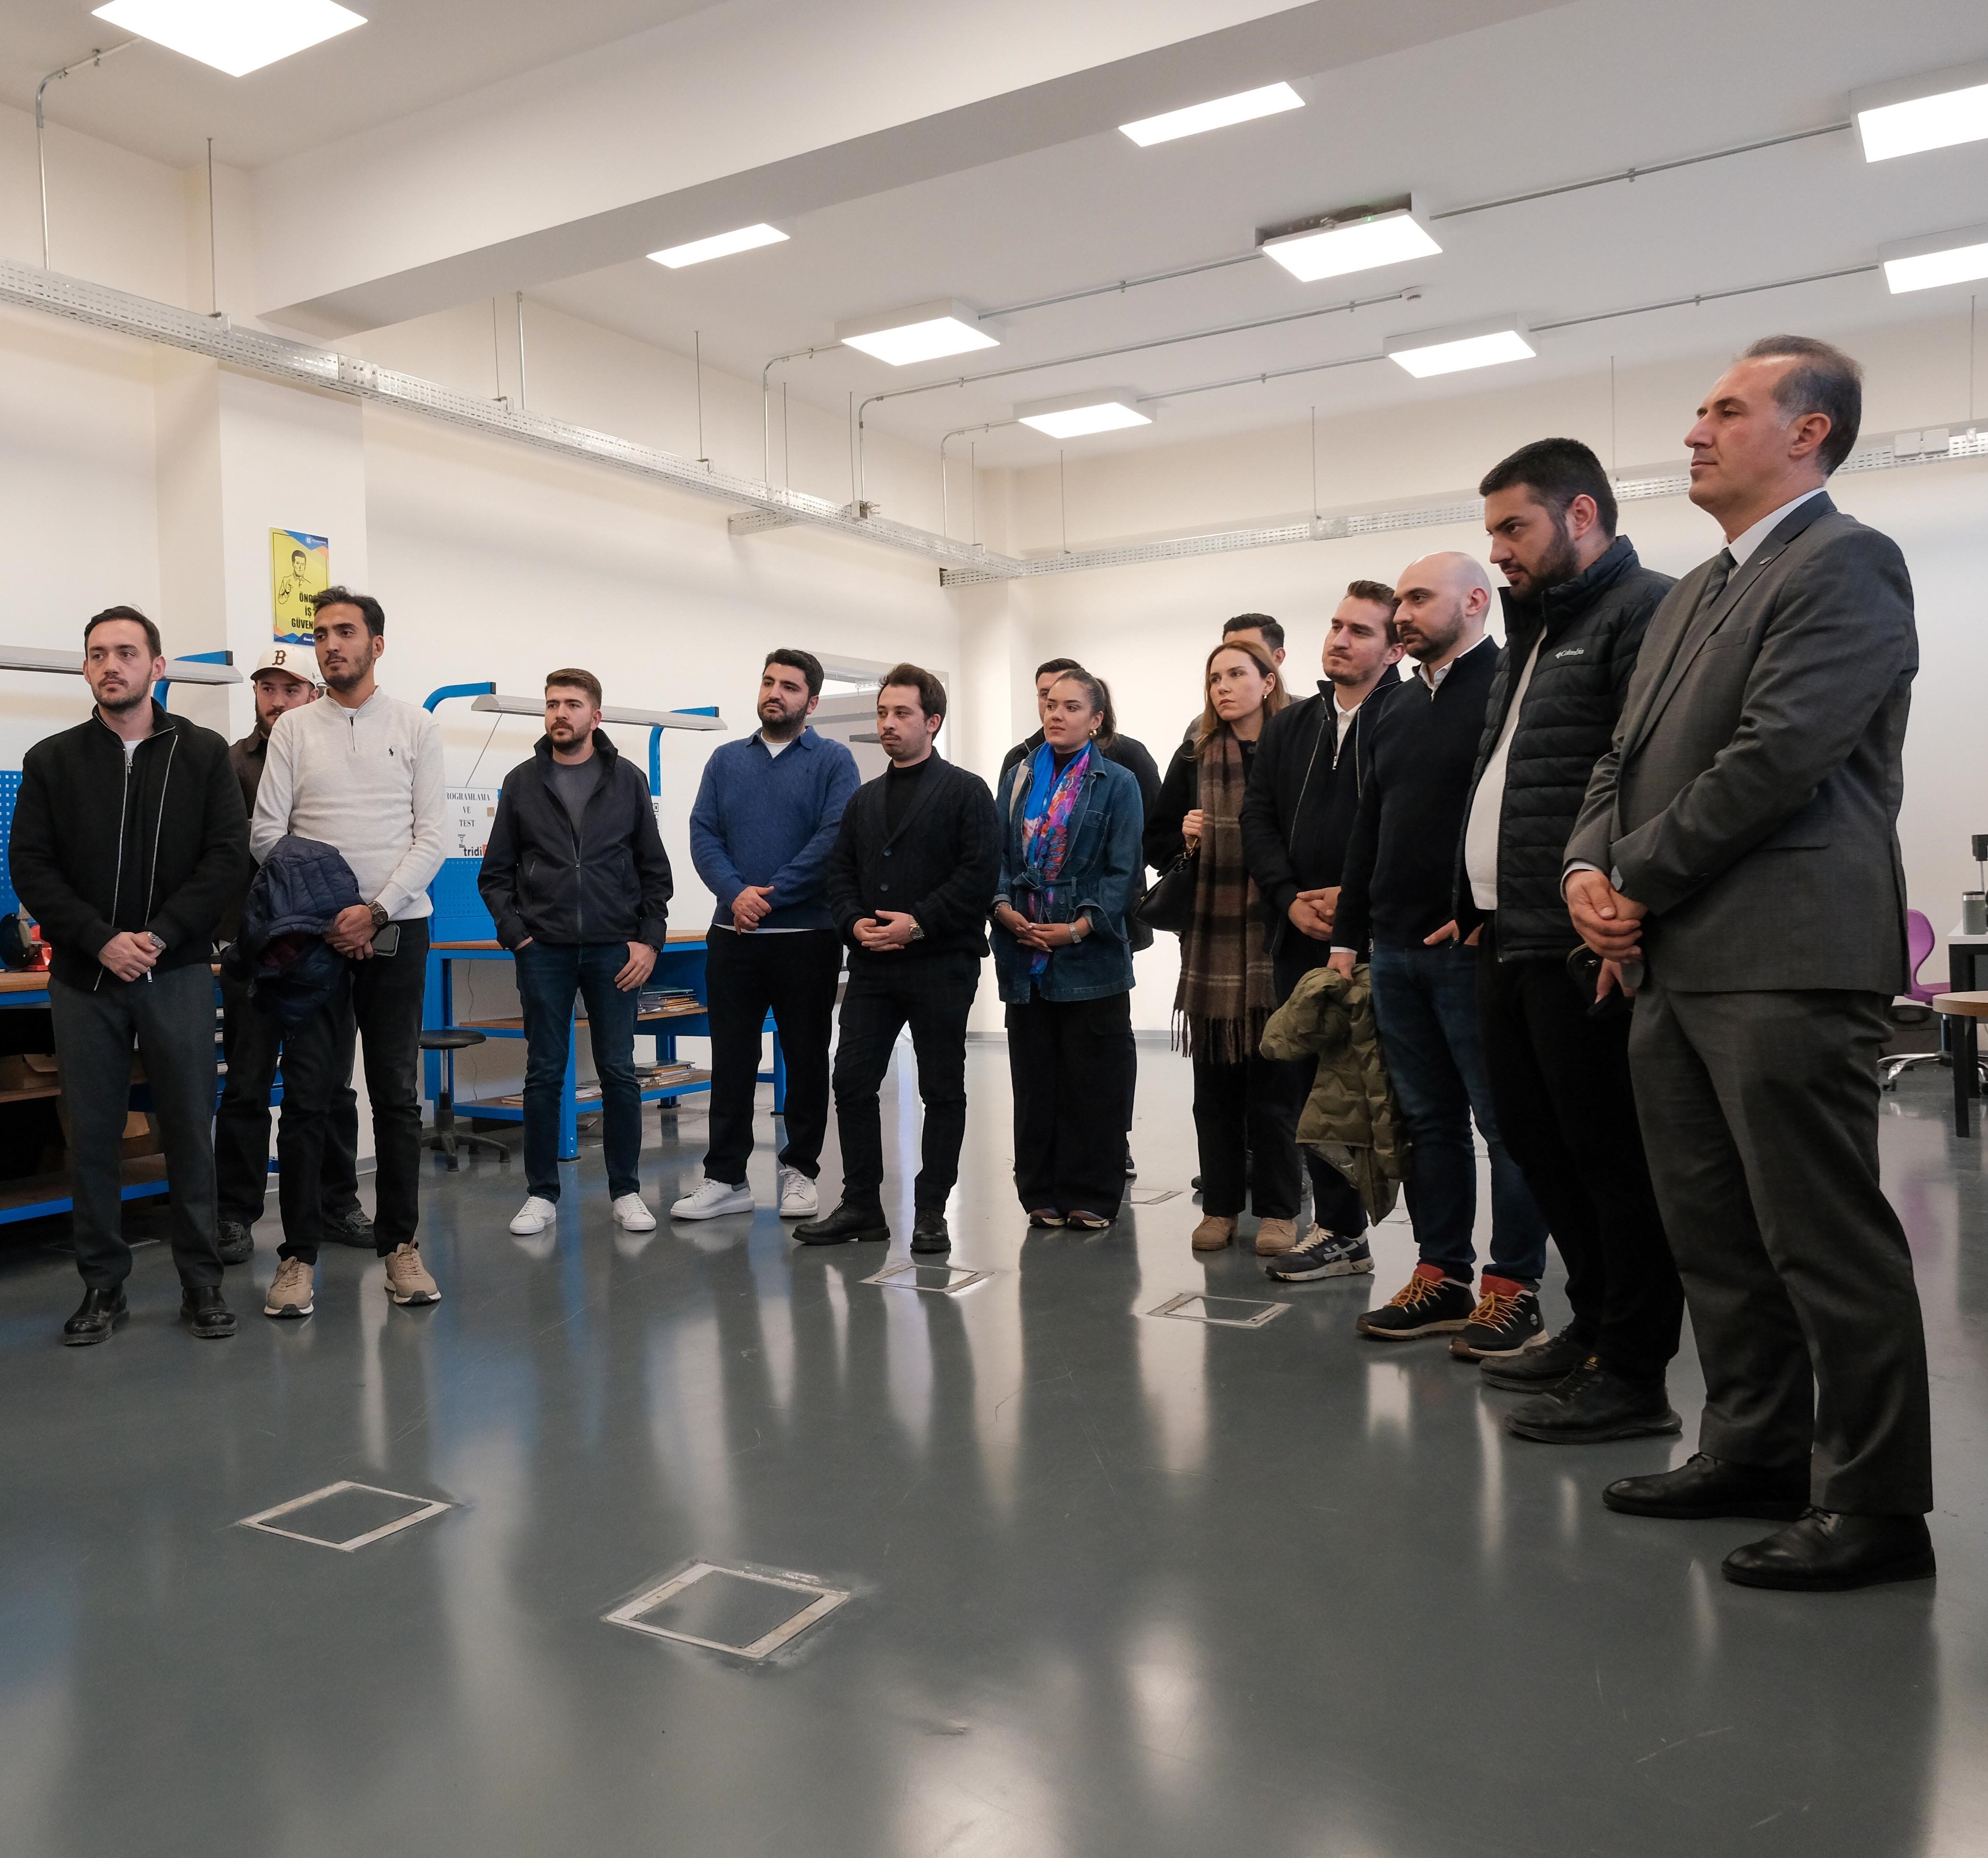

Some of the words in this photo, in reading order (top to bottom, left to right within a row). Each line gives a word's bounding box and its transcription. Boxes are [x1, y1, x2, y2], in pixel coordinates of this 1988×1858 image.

[305, 605, 312, 618] İŞ
[291, 617, 313, 630] GÜVEN
[272, 650, 286, 665] B
[447, 792, 490, 801] ROGRAMLAMA
[459, 819, 475, 827] TEST
[464, 846, 482, 857] tridi
